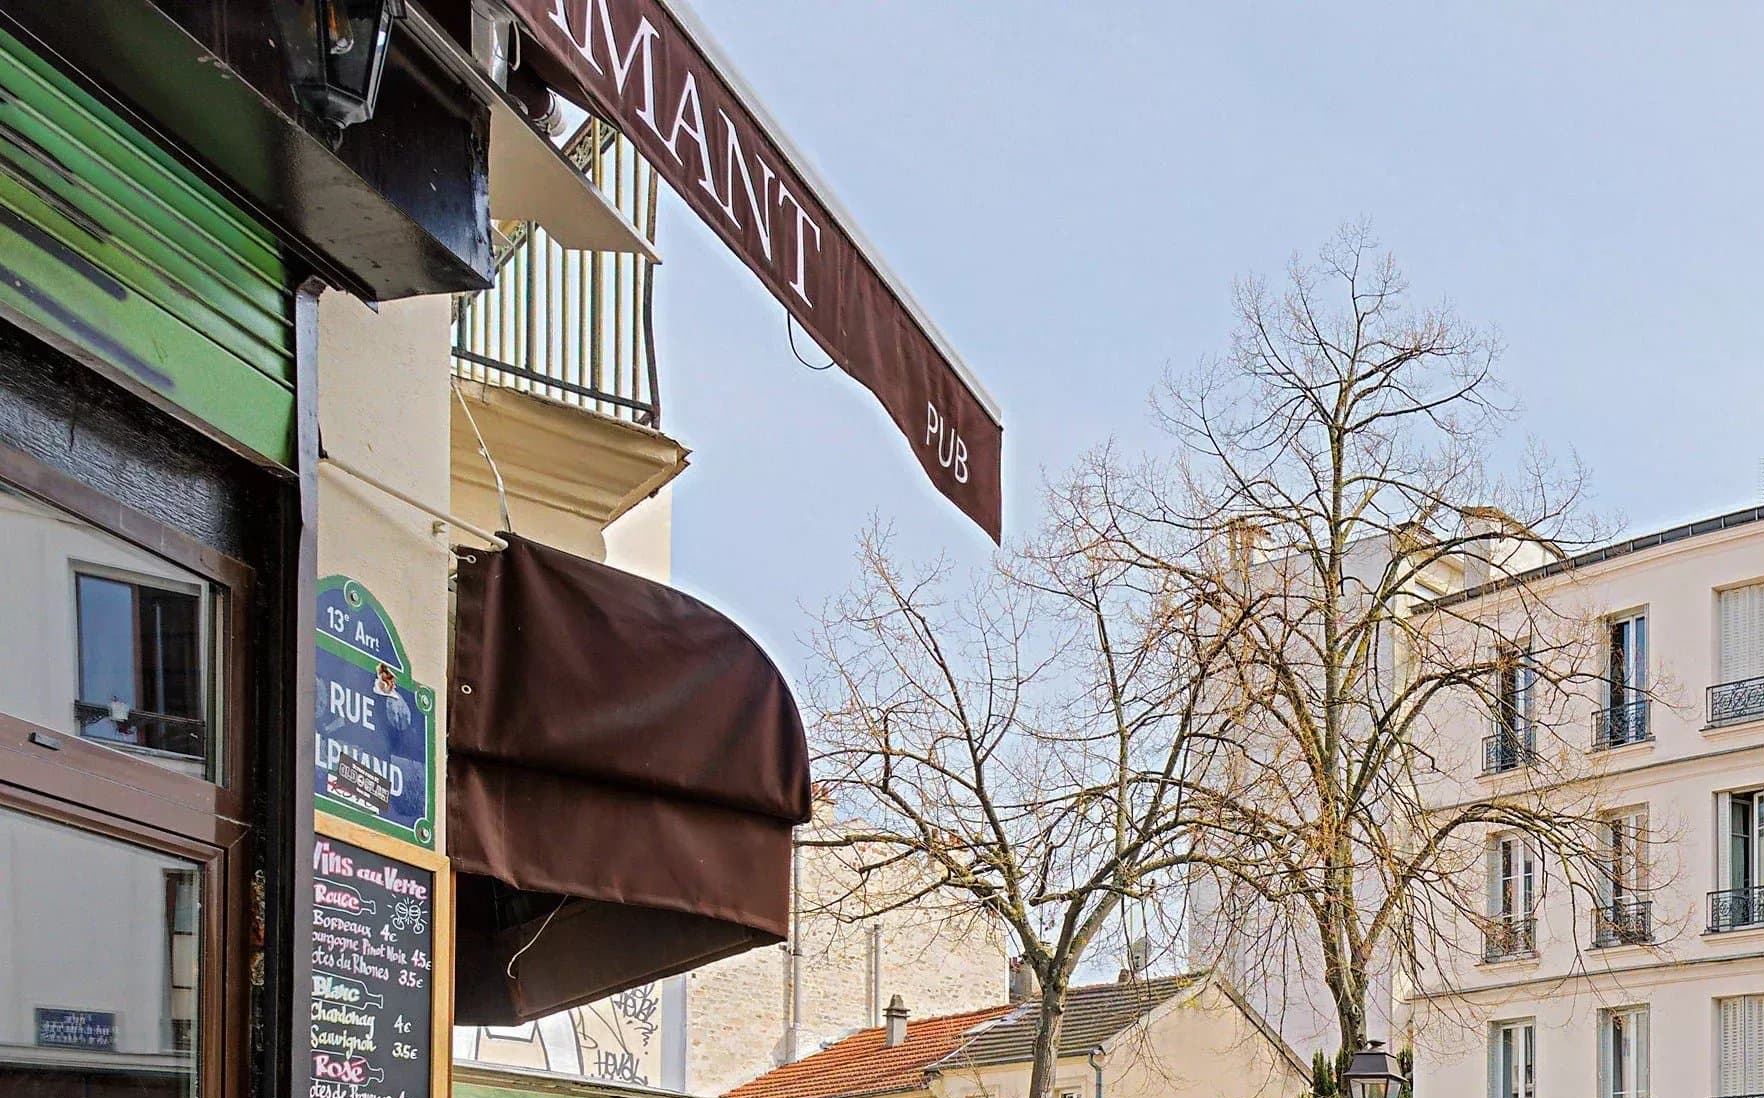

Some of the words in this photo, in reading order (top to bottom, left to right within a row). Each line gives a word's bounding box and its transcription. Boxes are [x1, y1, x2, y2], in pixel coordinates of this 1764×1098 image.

[548, 0, 821, 309] MANT
[926, 400, 969, 484] PUB
[330, 680, 376, 731] RUE
[337, 952, 352, 971] du
[314, 1054, 366, 1083] Rosé
